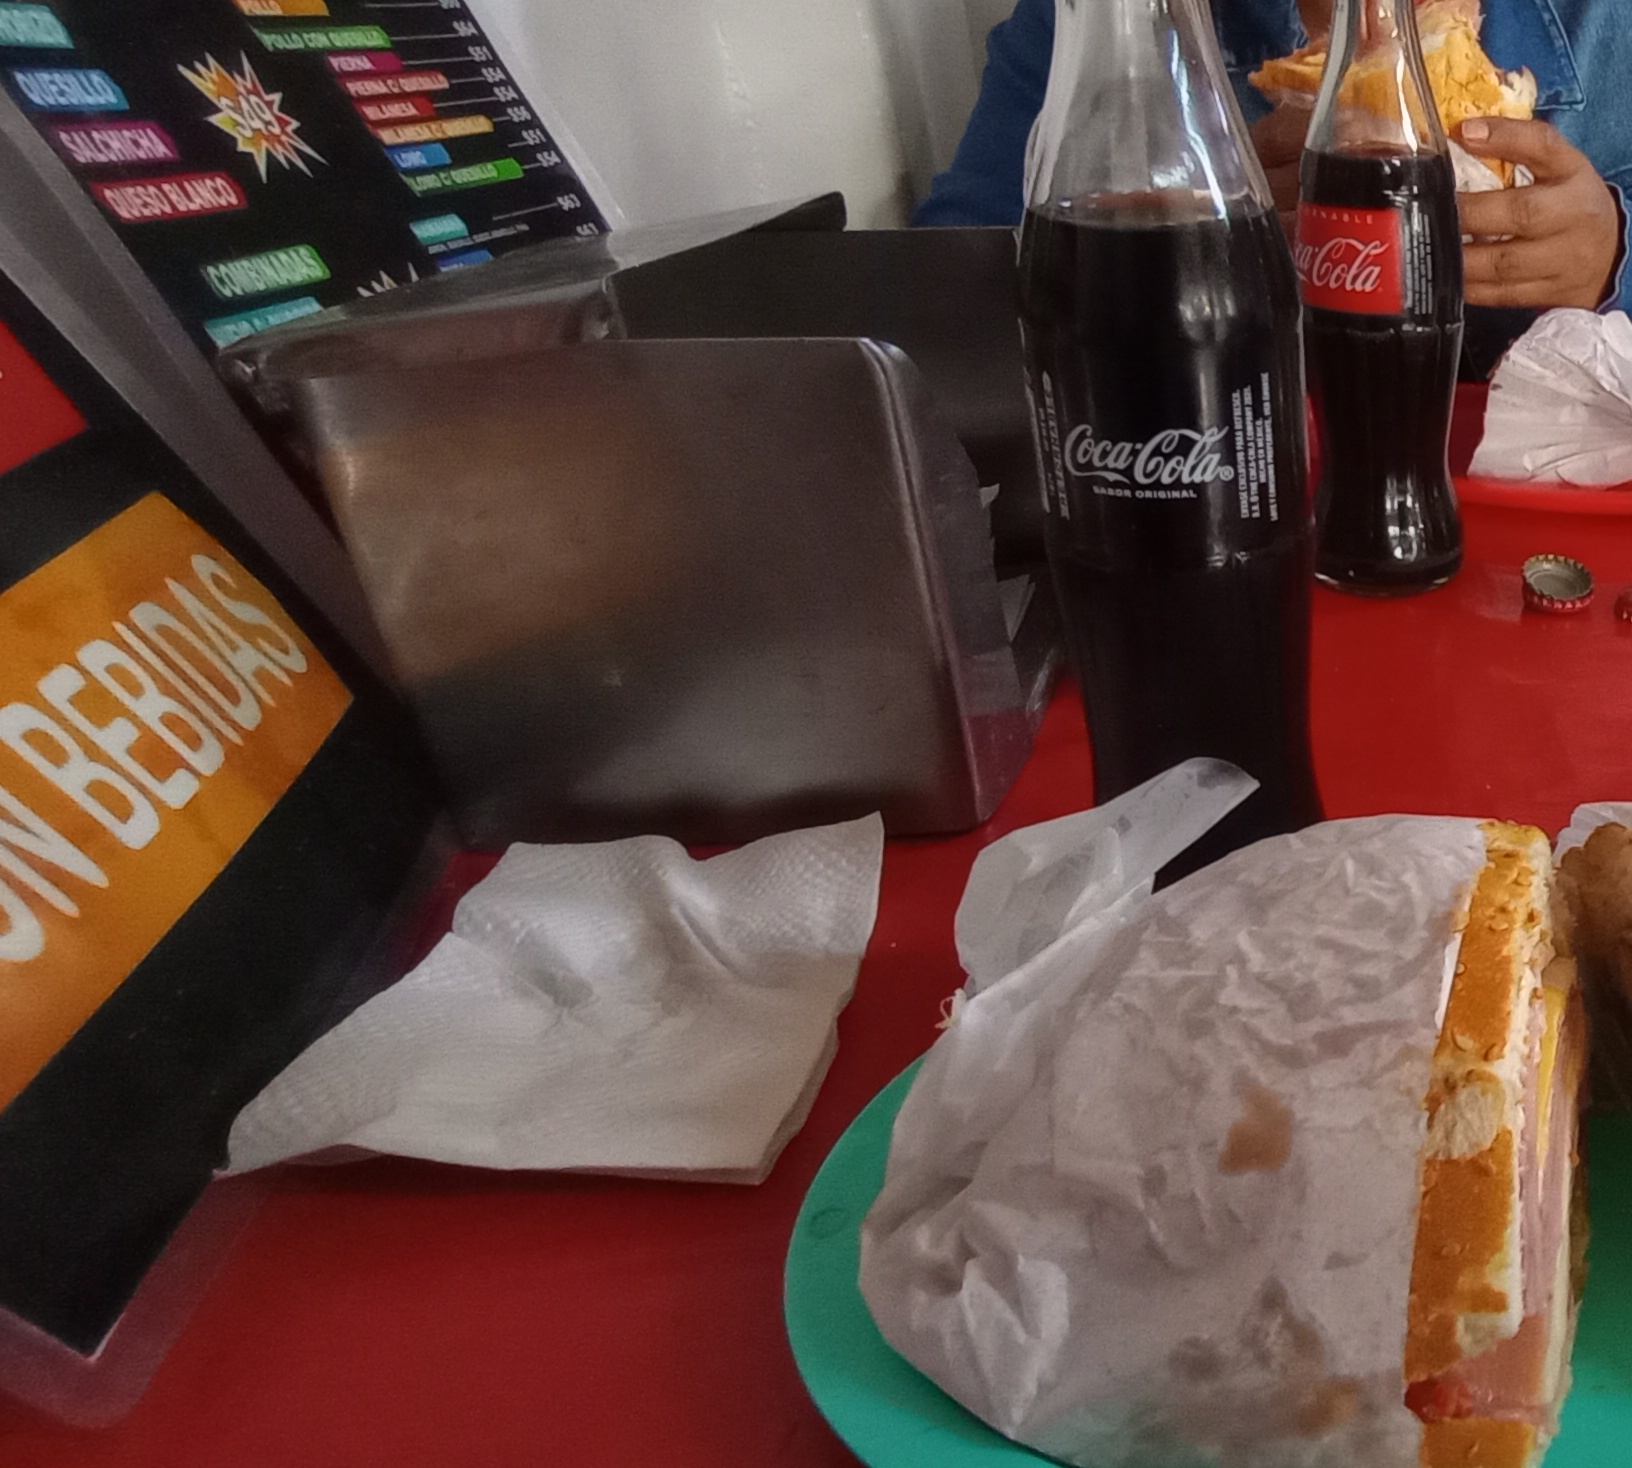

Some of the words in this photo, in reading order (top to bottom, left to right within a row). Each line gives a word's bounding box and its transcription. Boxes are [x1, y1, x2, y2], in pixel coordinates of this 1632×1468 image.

[262, 33, 304, 50] POLLO
[303, 33, 329, 48] CON
[328, 55, 376, 72] PIERNA
[467, 45, 493, 62] $51
[14, 70, 118, 107] QUESILLO
[346, 80, 390, 97] PIERNA
[218, 93, 281, 138] $49
[362, 102, 419, 120] MILANESA
[59, 128, 172, 163] SALCHICHA
[103, 185, 168, 220] QUESO
[161, 176, 239, 212] BLANCO
[206, 246, 324, 298] COMBINADAS
[1092, 484, 1133, 499] SABOR
[1134, 488, 1198, 500] ORIGINAL
[0, 553, 308, 851] BEBIDAS
